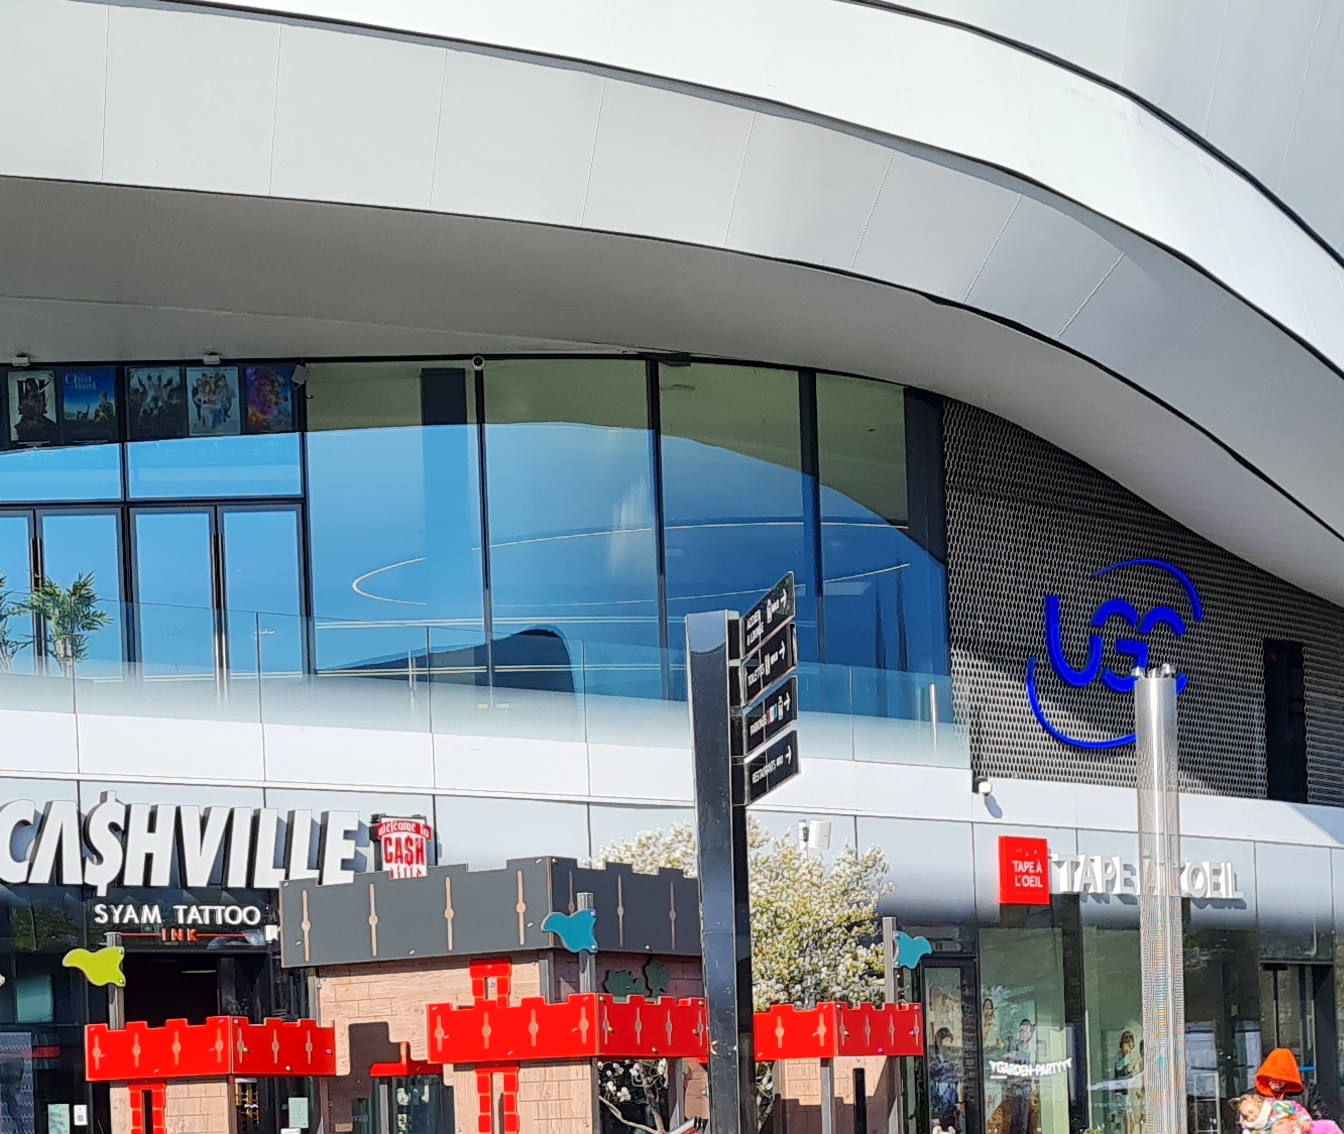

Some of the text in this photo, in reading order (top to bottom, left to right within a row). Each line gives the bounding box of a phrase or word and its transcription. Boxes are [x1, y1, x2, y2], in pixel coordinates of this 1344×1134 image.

[1012, 858, 1043, 874] TAPE À
[1046, 852, 1140, 894] TAPE
[1014, 874, 1043, 888] L'OEIL
[94, 904, 261, 926] SYAM TATTOO
[161, 928, 198, 942] INK
[996, 1058, 1062, 1077] GARDEN-PARTY
